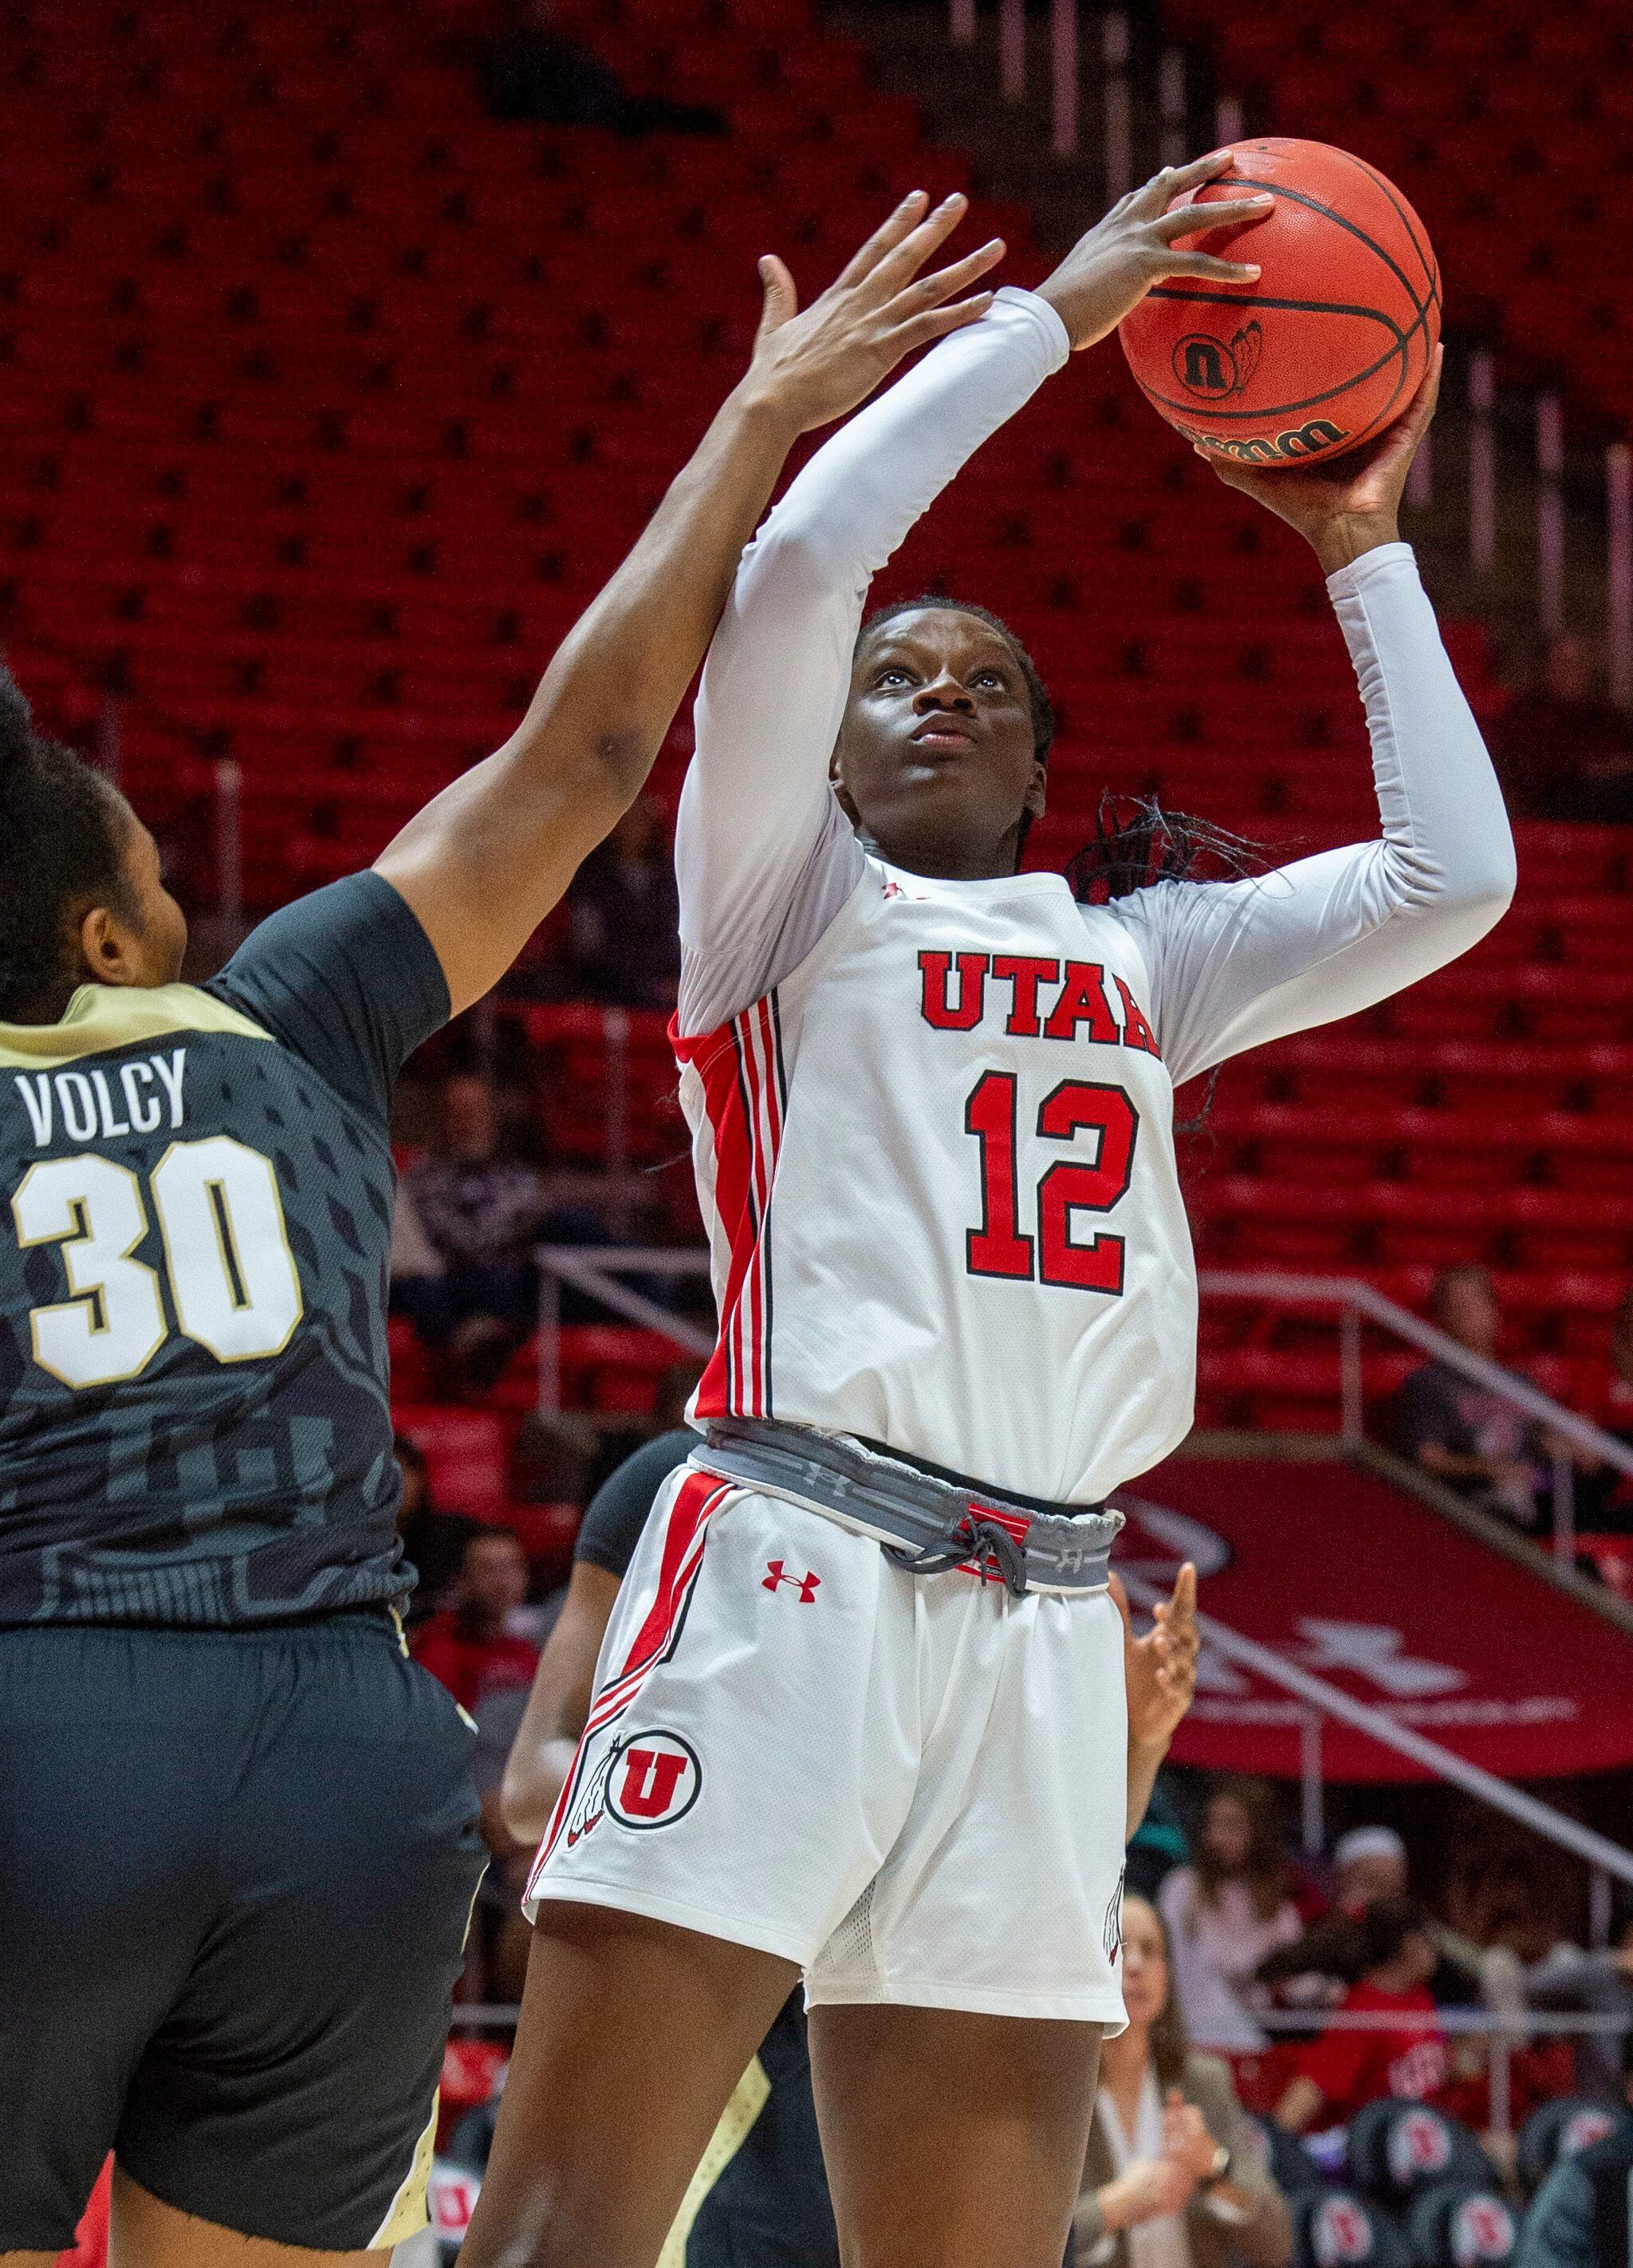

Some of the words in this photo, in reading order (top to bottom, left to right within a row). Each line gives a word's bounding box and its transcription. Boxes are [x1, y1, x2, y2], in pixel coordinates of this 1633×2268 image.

[918, 950, 1163, 1062] UTAH
[14, 1048, 187, 1147] VOLCY
[964, 1069, 1140, 1297] 12
[10, 1134, 305, 1391] 30
[619, 1747, 687, 1819] U
